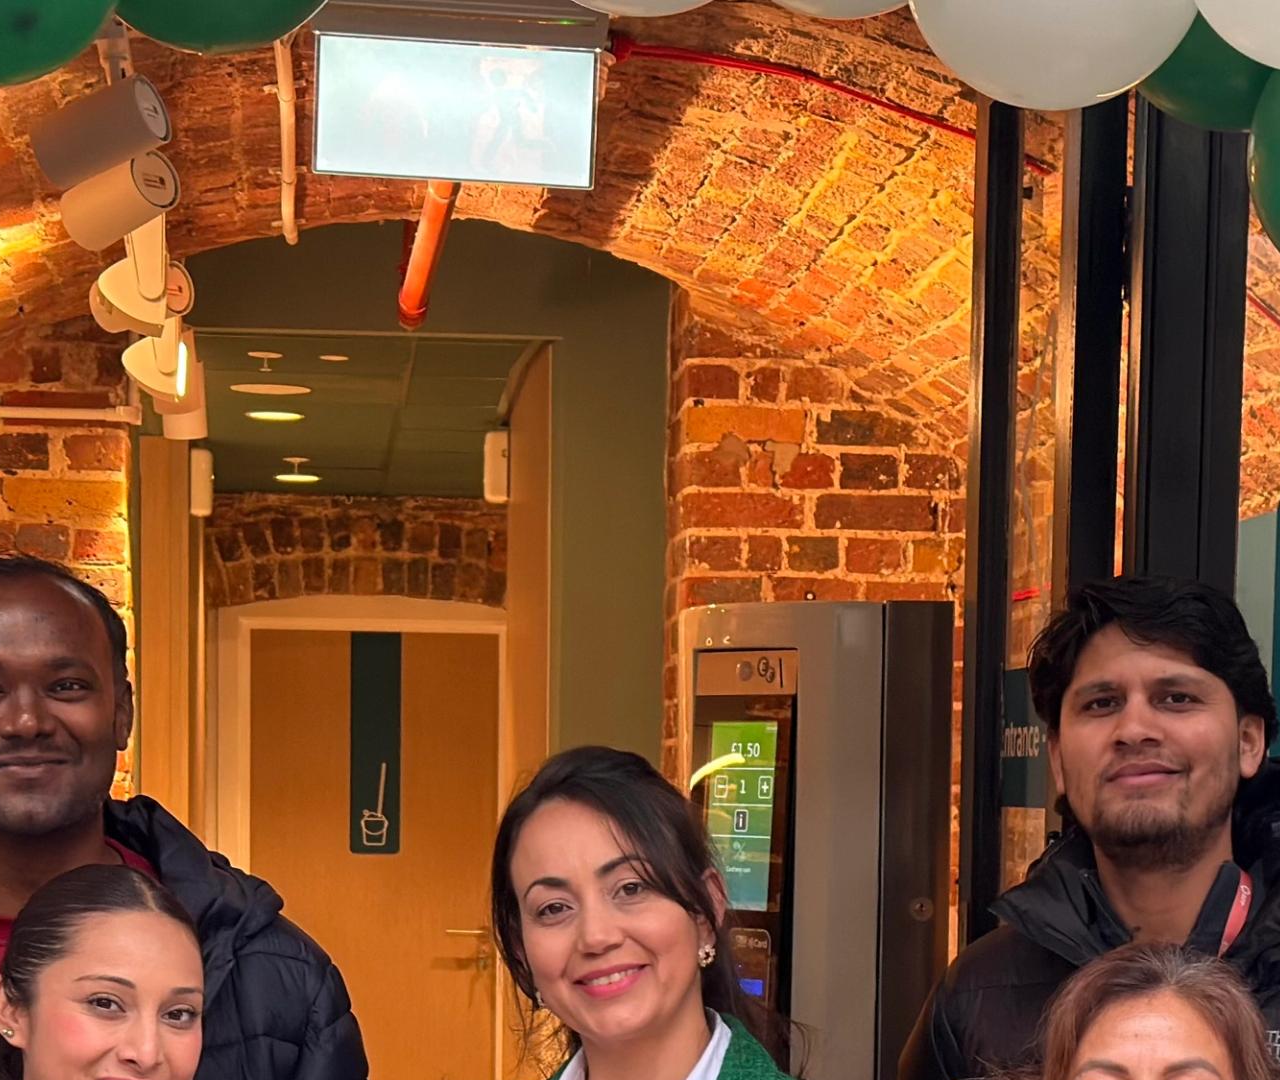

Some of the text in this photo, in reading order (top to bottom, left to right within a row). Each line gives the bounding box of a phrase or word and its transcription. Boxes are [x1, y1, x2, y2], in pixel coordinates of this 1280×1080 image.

[1000, 721, 1040, 757] ntrance
[731, 743, 761, 758] £1.50
[740, 779, 747, 794] 1
